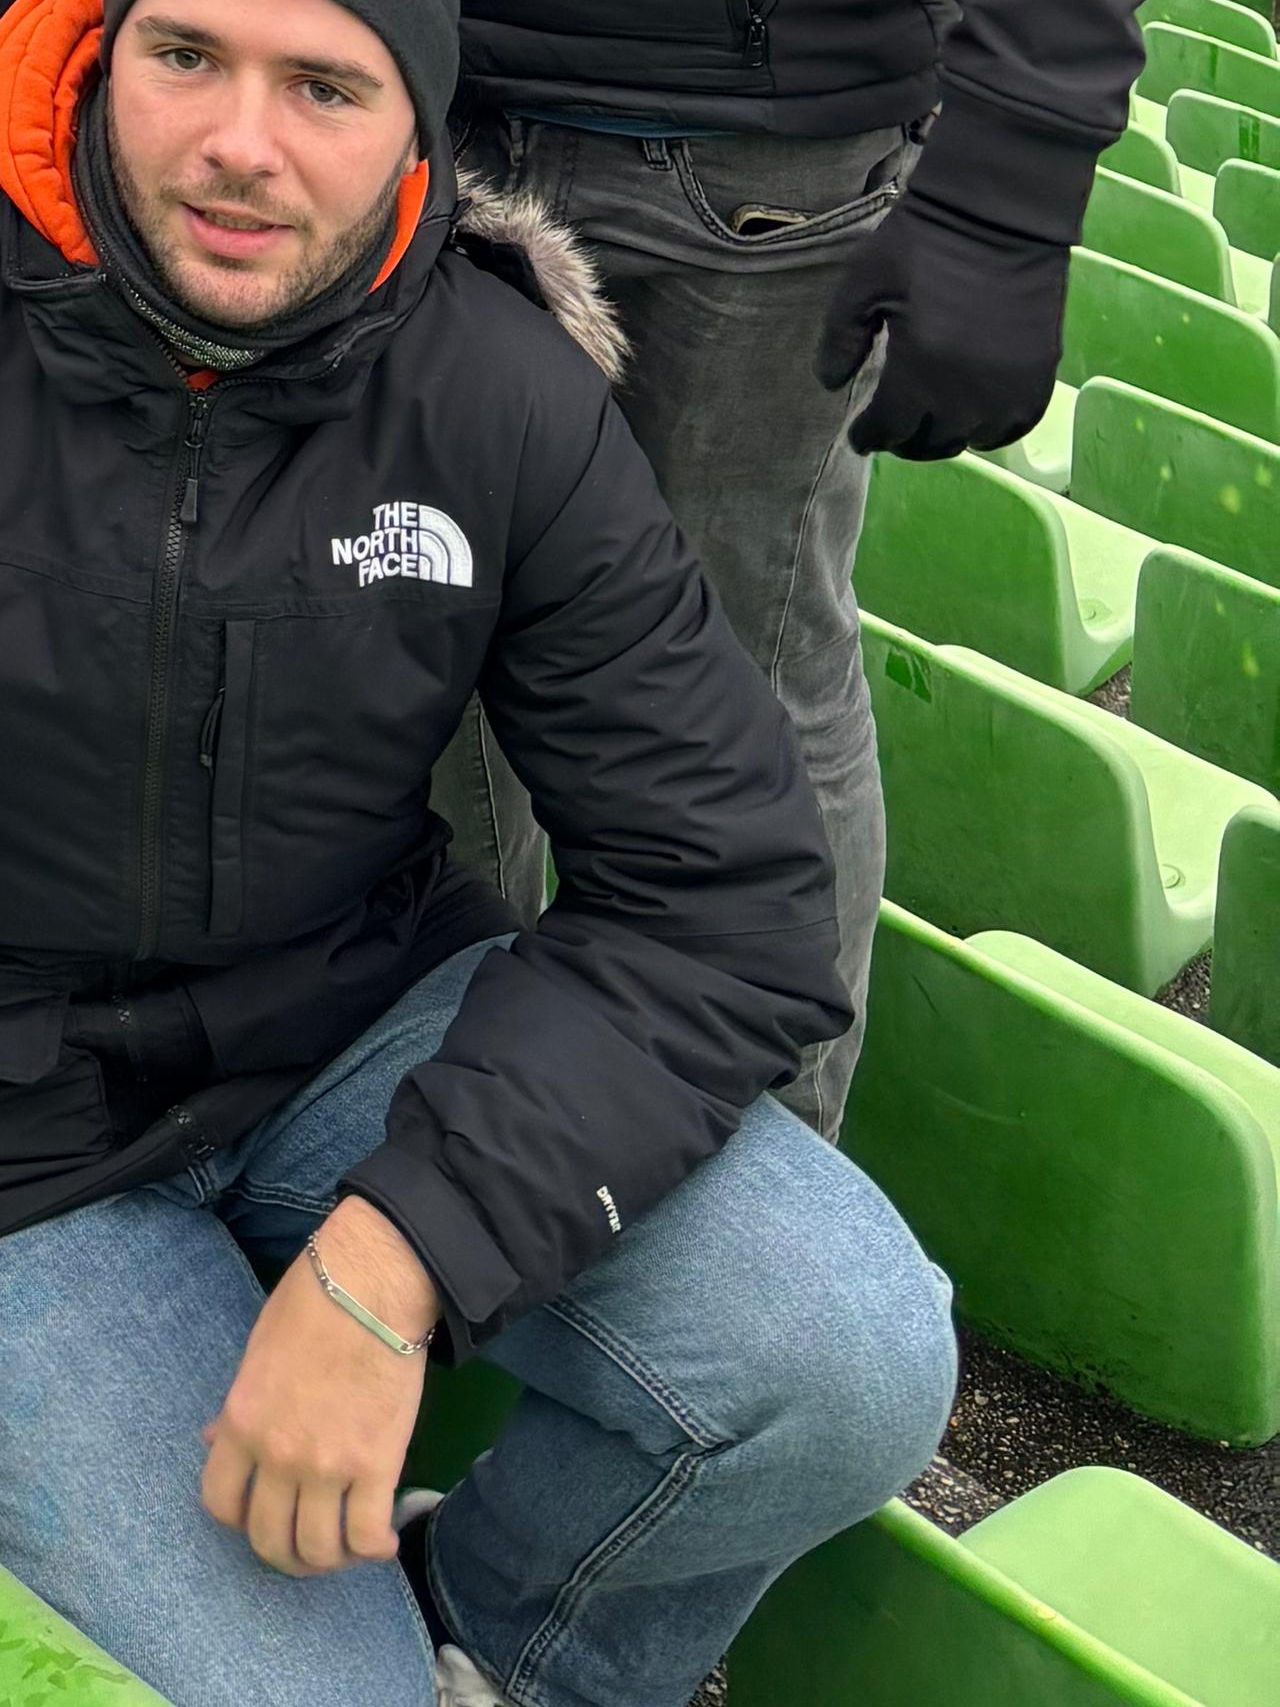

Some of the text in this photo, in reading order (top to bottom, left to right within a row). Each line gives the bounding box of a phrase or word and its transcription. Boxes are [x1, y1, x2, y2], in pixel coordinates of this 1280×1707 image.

[373, 501, 418, 530] THE
[331, 528, 418, 565] NORTH
[358, 552, 418, 588] FACE
